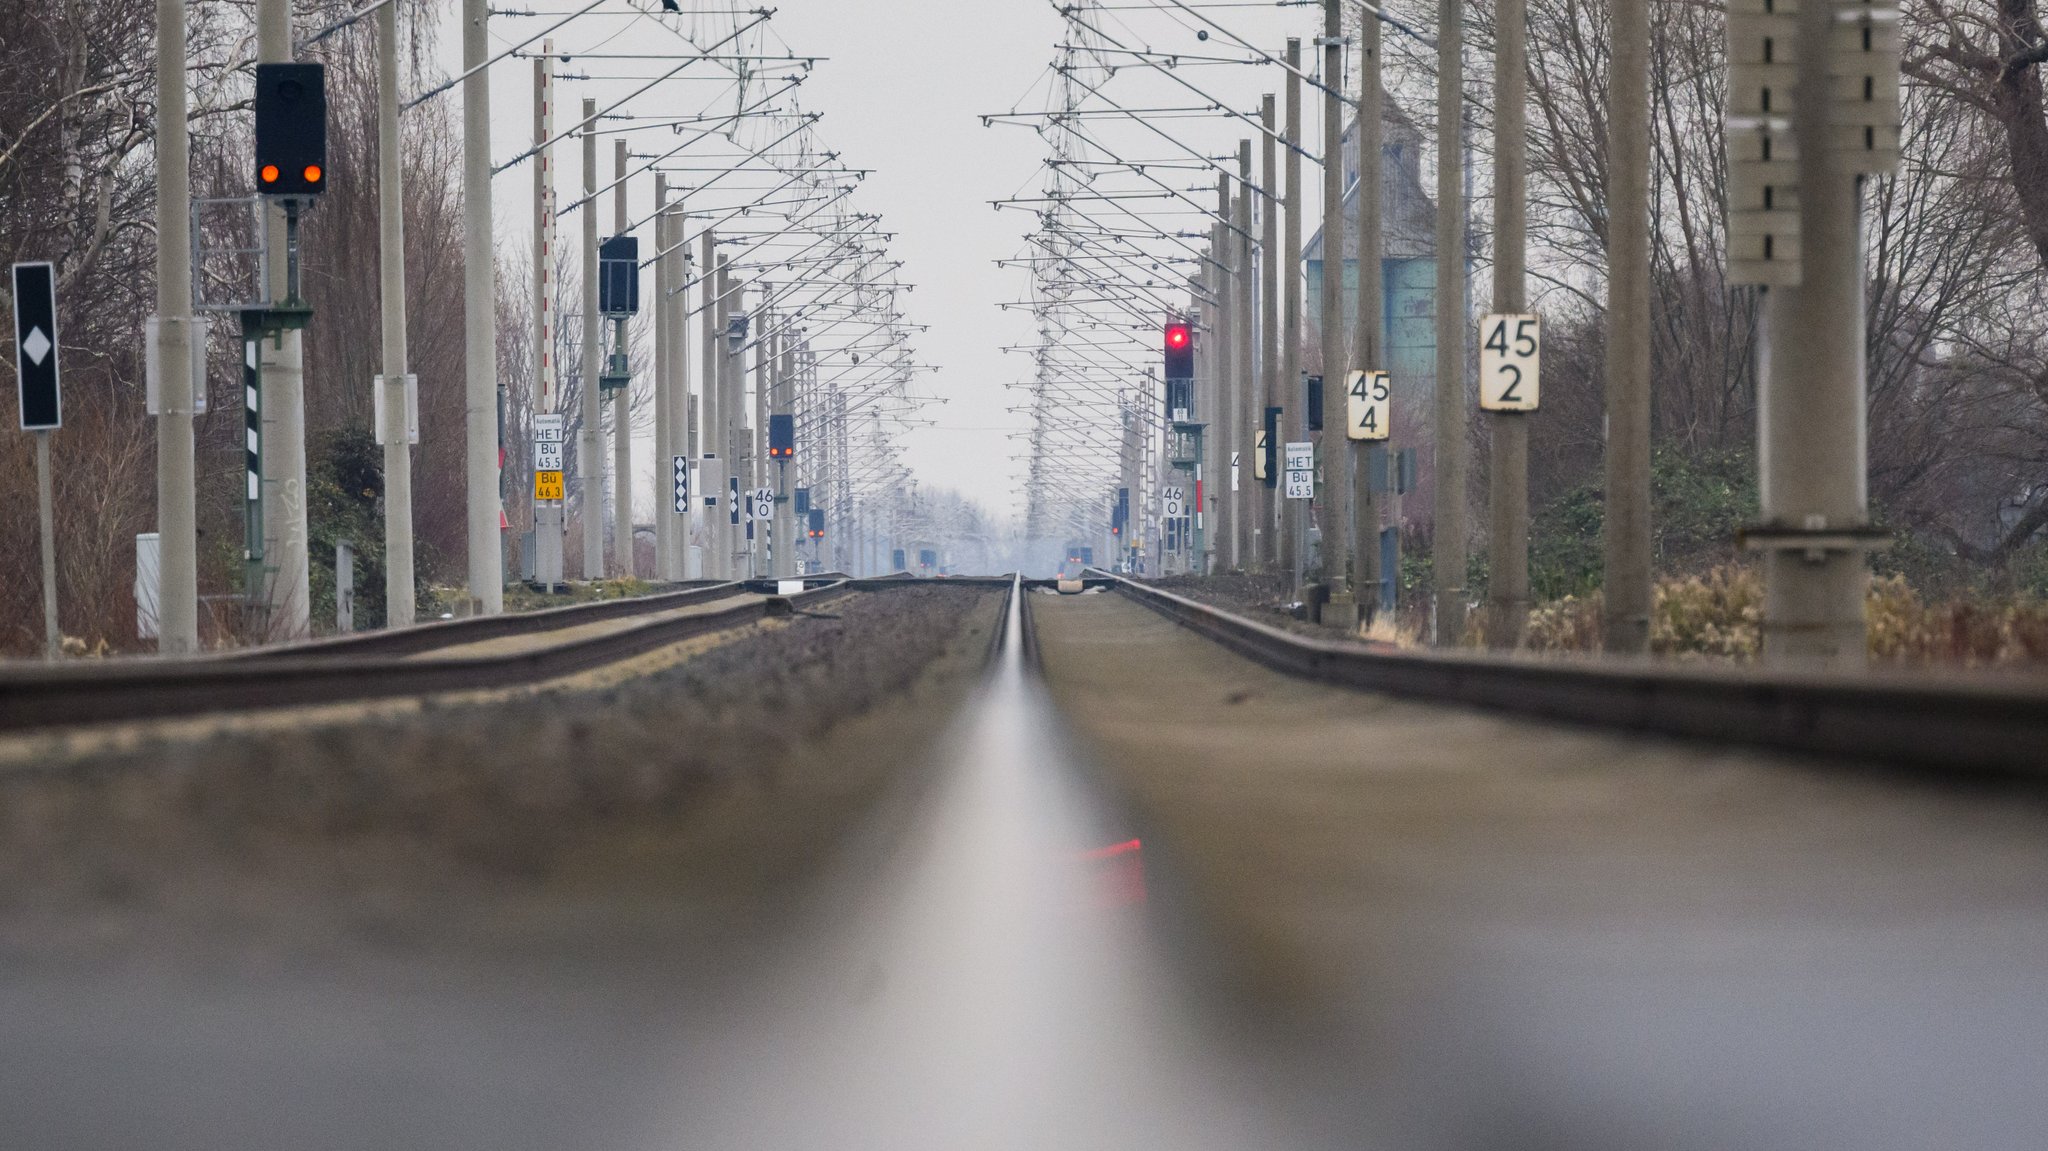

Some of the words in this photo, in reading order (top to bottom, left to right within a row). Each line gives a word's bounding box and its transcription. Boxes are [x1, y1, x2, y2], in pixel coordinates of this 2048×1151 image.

[1484, 319, 1537, 358] 45
[1350, 373, 1390, 401] 45
[1498, 364, 1522, 402] 2
[1359, 405, 1377, 433] 4
[536, 429, 560, 439] HET
[541, 443, 556, 454] Bü
[538, 457, 560, 468] 45.5
[1287, 456, 1312, 467] HET
[541, 473, 557, 483] Bü
[1292, 472, 1308, 482] Bü
[755, 489, 773, 502] 46
[1163, 487, 1182, 500] 46
[1289, 485, 1311, 496] 45.5
[758, 503, 769, 516] 0
[1167, 501, 1177, 514] 0
